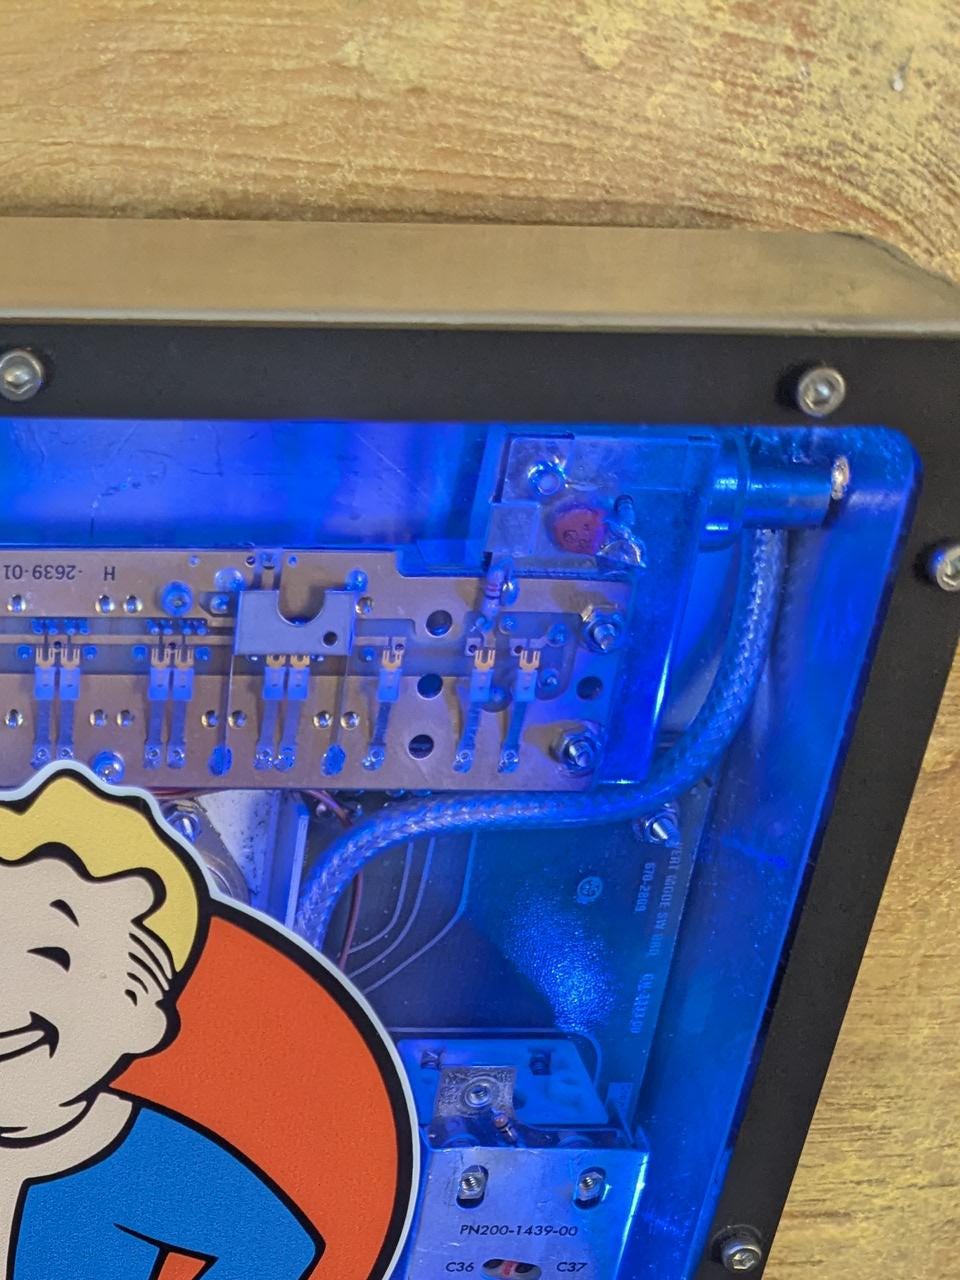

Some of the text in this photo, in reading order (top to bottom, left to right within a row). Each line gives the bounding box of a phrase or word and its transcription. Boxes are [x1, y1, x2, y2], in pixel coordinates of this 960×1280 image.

[103, 565, 117, 581] H
[458, 1224, 579, 1237] PN200-1439-00
[445, 1261, 475, 1273] C36
[556, 1261, 588, 1273] C37
